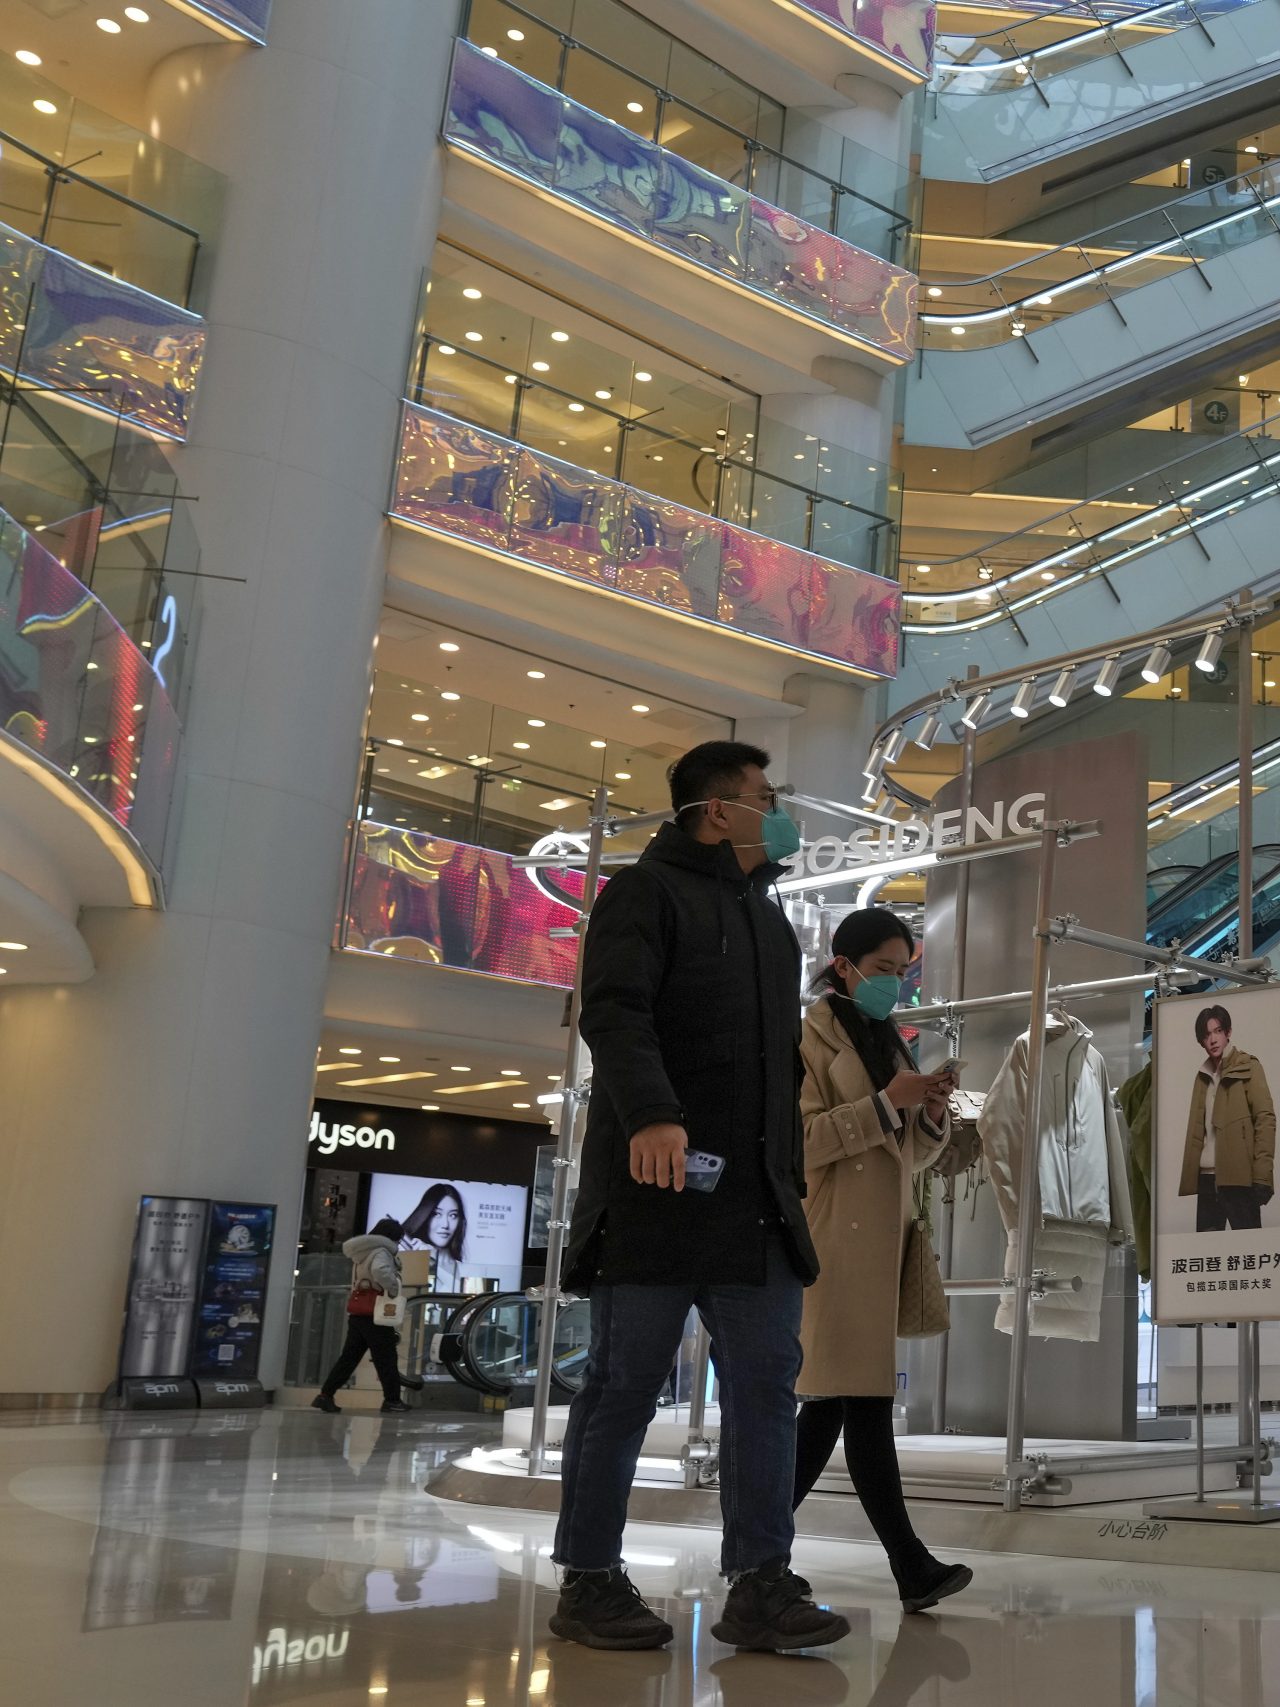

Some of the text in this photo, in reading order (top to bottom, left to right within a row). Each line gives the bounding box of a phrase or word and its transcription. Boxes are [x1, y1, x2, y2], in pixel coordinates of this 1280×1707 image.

[1204, 167, 1225, 183] 5F
[1206, 404, 1227, 421] 4F
[1171, 1257, 1222, 1274] 波司登
[1186, 1278, 1272, 1293] 包揽五项国际大奖
[145, 1385, 179, 1397] apm
[216, 1384, 249, 1396] apm
[1098, 1520, 1168, 1541] 小心台阶
